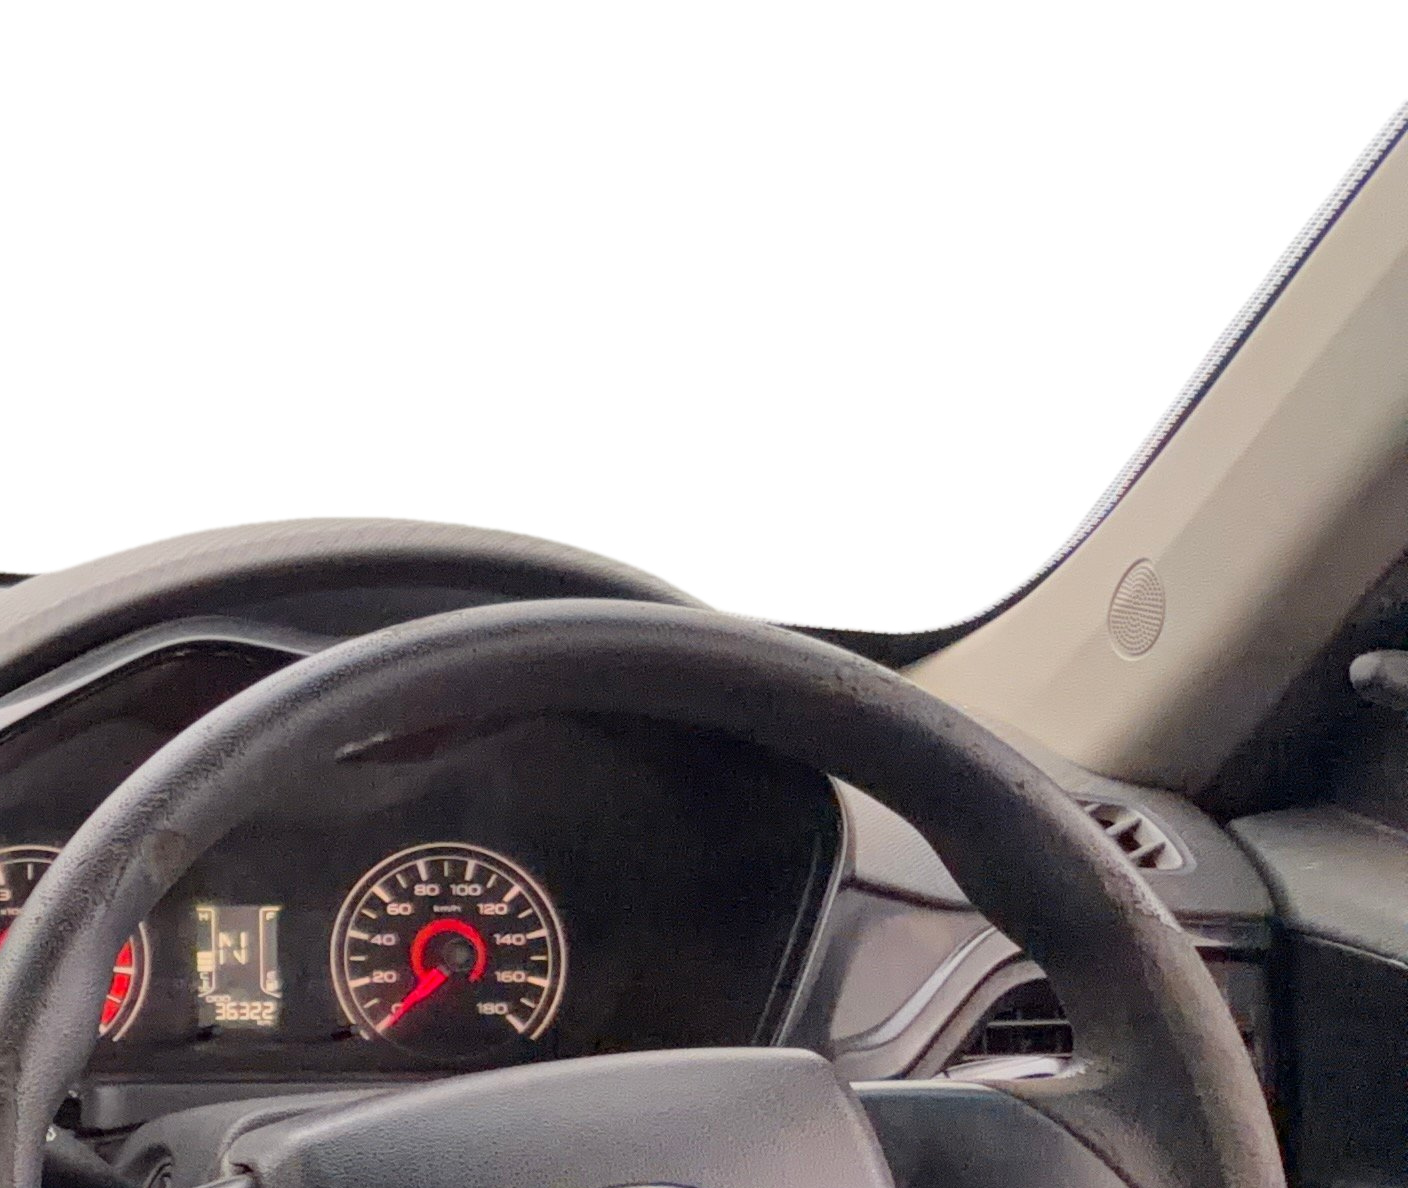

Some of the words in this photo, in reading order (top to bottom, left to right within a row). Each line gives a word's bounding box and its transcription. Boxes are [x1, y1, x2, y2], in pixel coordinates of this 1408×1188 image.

[414, 884, 440, 896] 80
[450, 884, 482, 896] 100
[387, 903, 412, 915] 60
[478, 903, 507, 915] 120
[370, 933, 396, 946] 40
[494, 933, 526, 946] 140
[372, 970, 397, 983] 20
[496, 970, 526, 983] 160
[214, 1001, 275, 1021] 36322
[477, 1002, 508, 1015] 180
